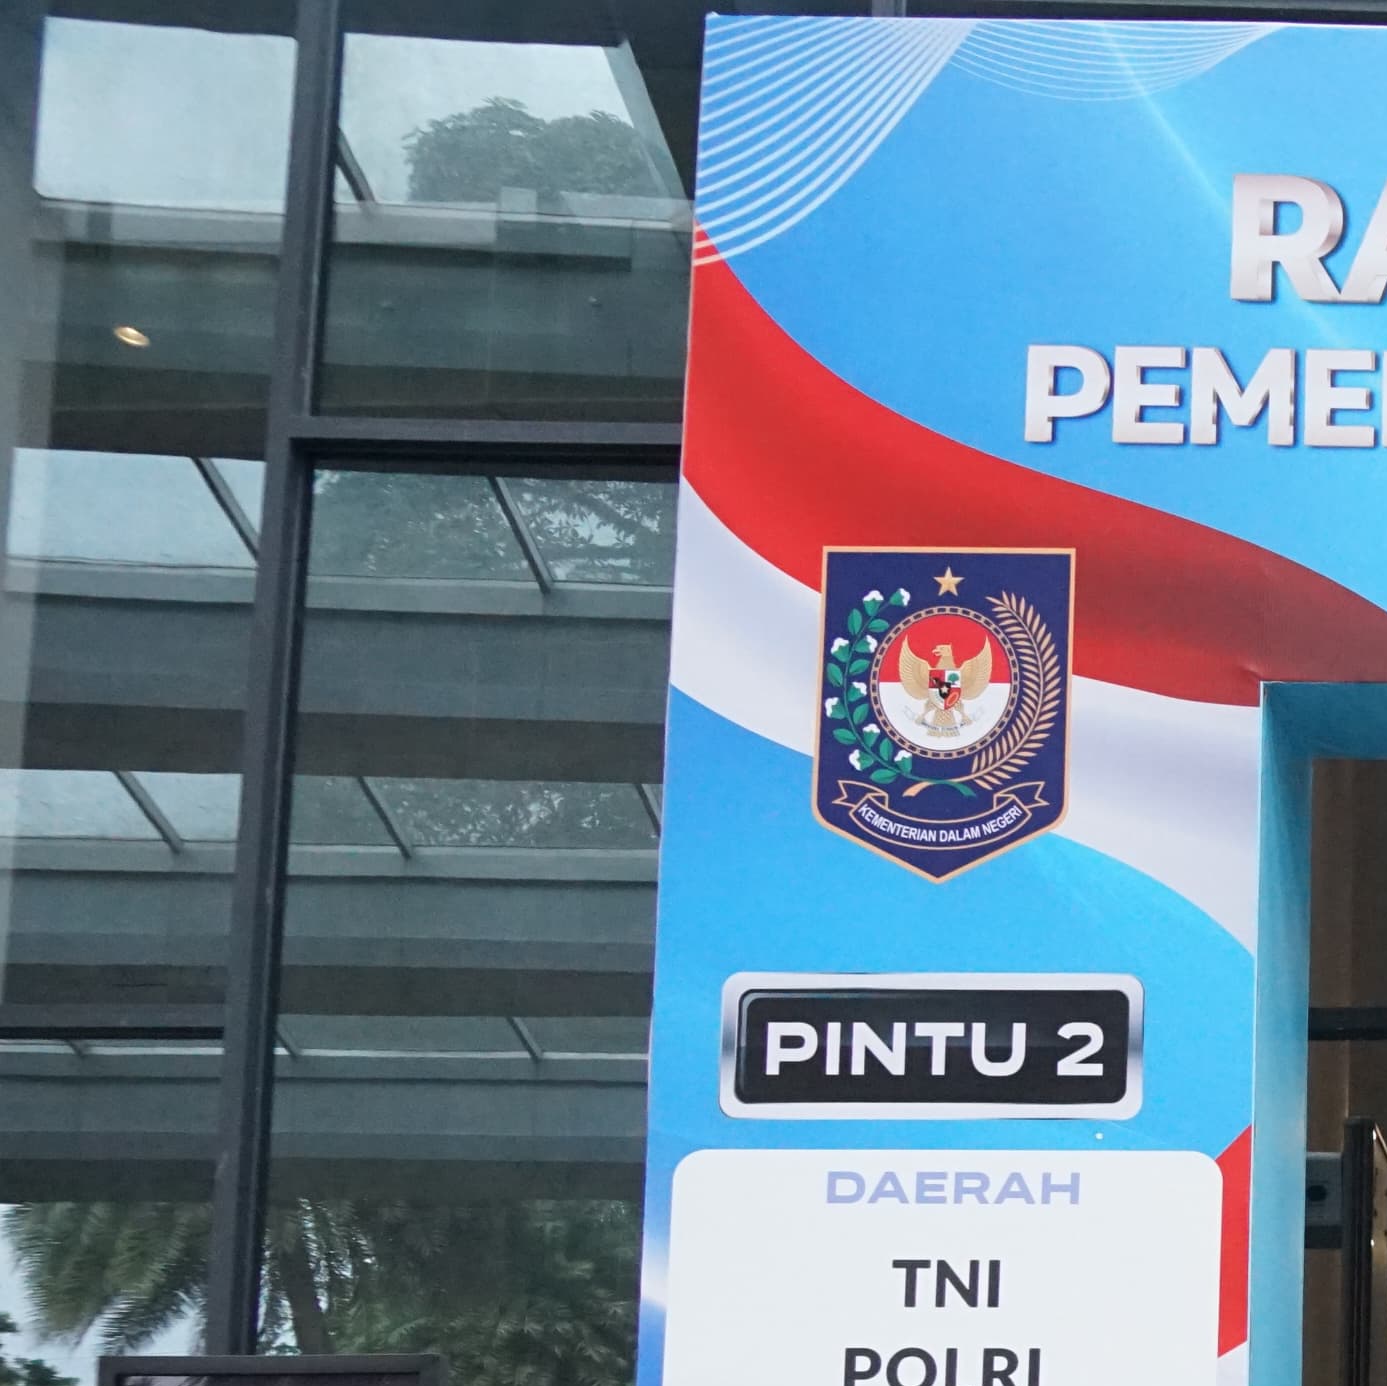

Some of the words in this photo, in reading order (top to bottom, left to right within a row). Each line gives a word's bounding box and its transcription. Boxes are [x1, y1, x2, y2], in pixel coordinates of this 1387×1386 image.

[858, 803, 937, 843] KEMENTERIAN
[939, 825, 982, 843] DALAM
[983, 805, 1023, 836] NEGERI
[765, 1022, 1027, 1077] PINTU
[1056, 1022, 1105, 1076] 2
[826, 1171, 1081, 1206] DAERAH
[892, 1259, 1001, 1308] TNI
